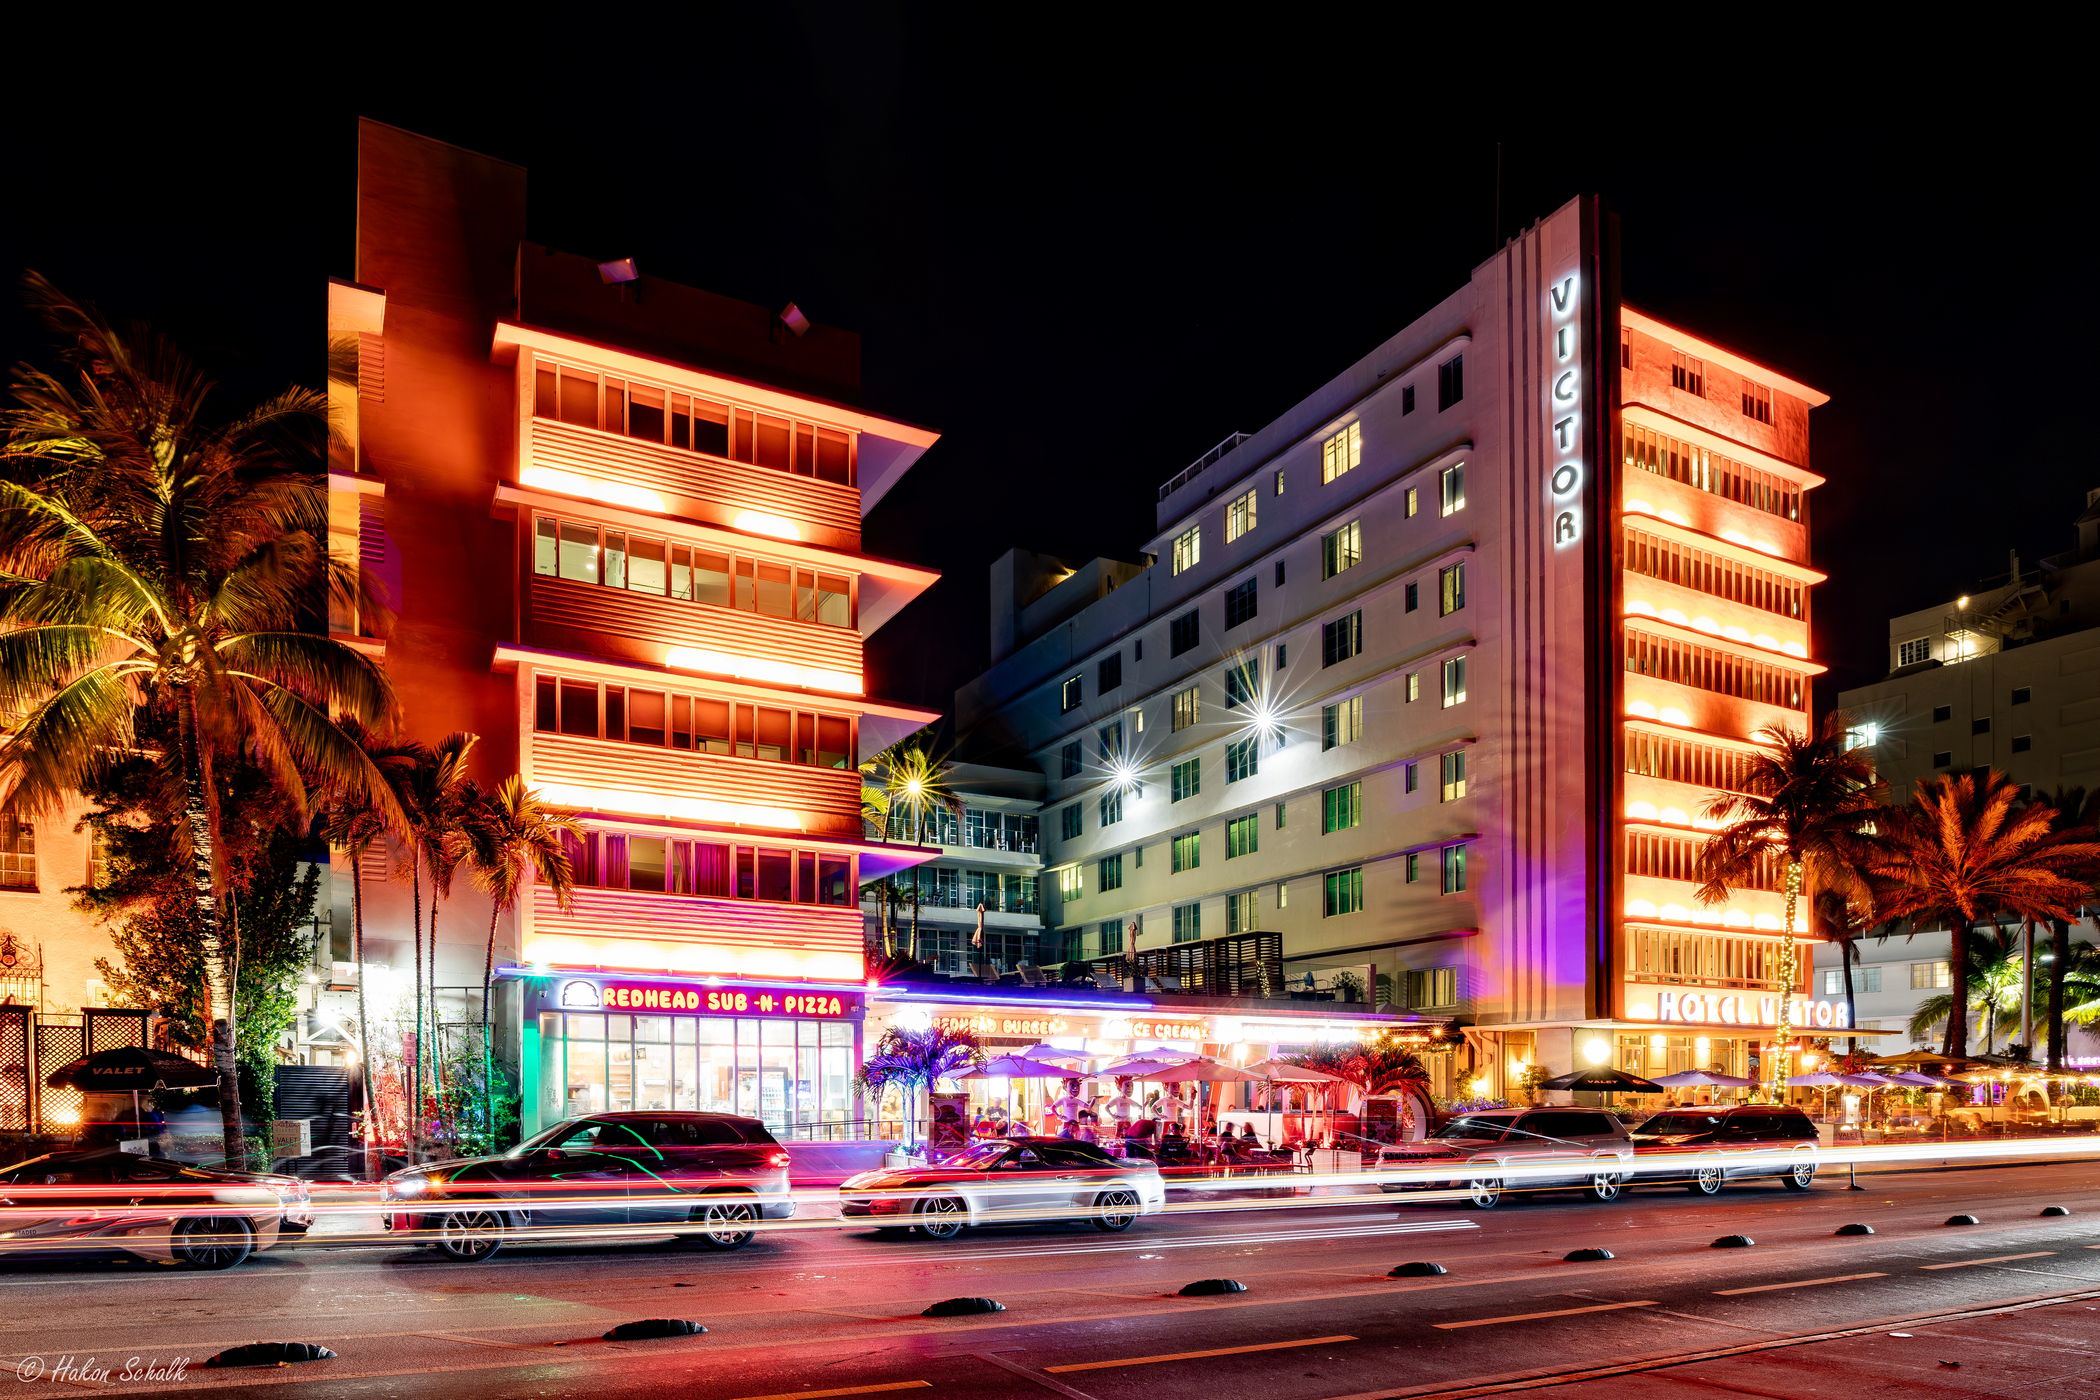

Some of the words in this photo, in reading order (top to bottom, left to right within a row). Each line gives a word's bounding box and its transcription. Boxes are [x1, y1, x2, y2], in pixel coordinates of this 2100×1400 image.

[1551, 277, 1579, 544] VICTOR
[603, 988, 700, 1010] REDHEAD
[707, 992, 748, 1012] SUB
[785, 996, 842, 1015] PIZZA
[1658, 992, 1751, 1024] HOTEL
[92, 1066, 145, 1075] VALET
